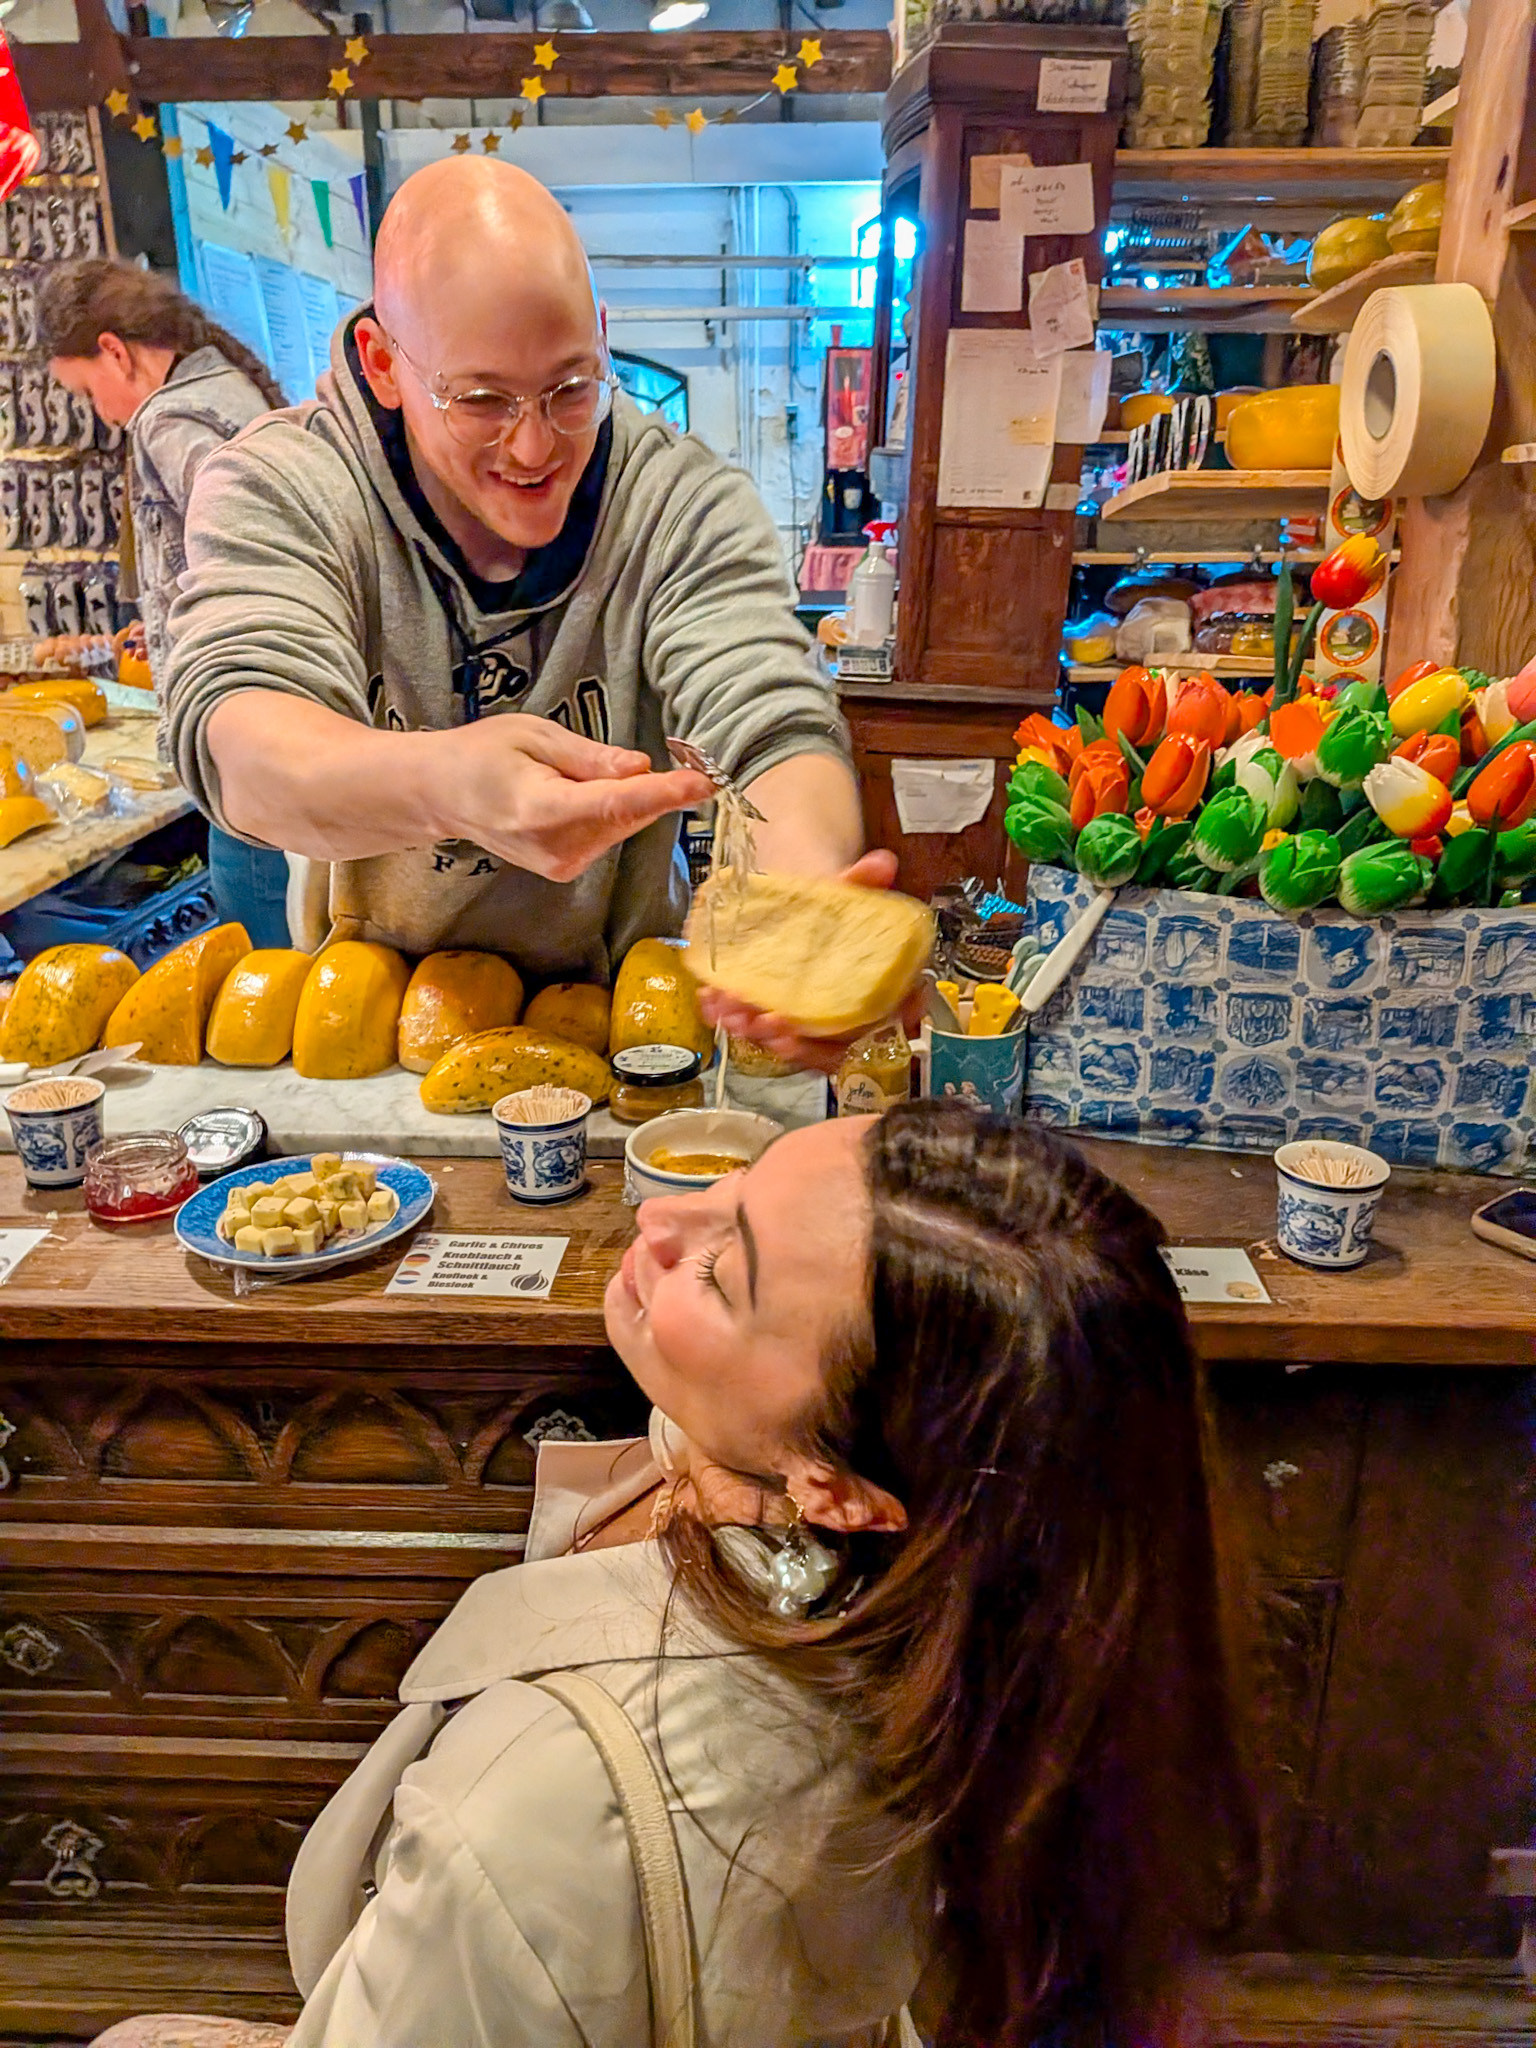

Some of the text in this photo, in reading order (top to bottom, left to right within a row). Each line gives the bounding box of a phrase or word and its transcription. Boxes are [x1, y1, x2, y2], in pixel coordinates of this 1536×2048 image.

[448, 1240, 487, 1249] Garlic
[500, 1241, 544, 1250] Chives
[442, 1251, 512, 1260] Knoblauch
[437, 1261, 522, 1271] Schnittlauch
[432, 1272, 480, 1280] Knoflook
[427, 1281, 475, 1289] Bieslook
